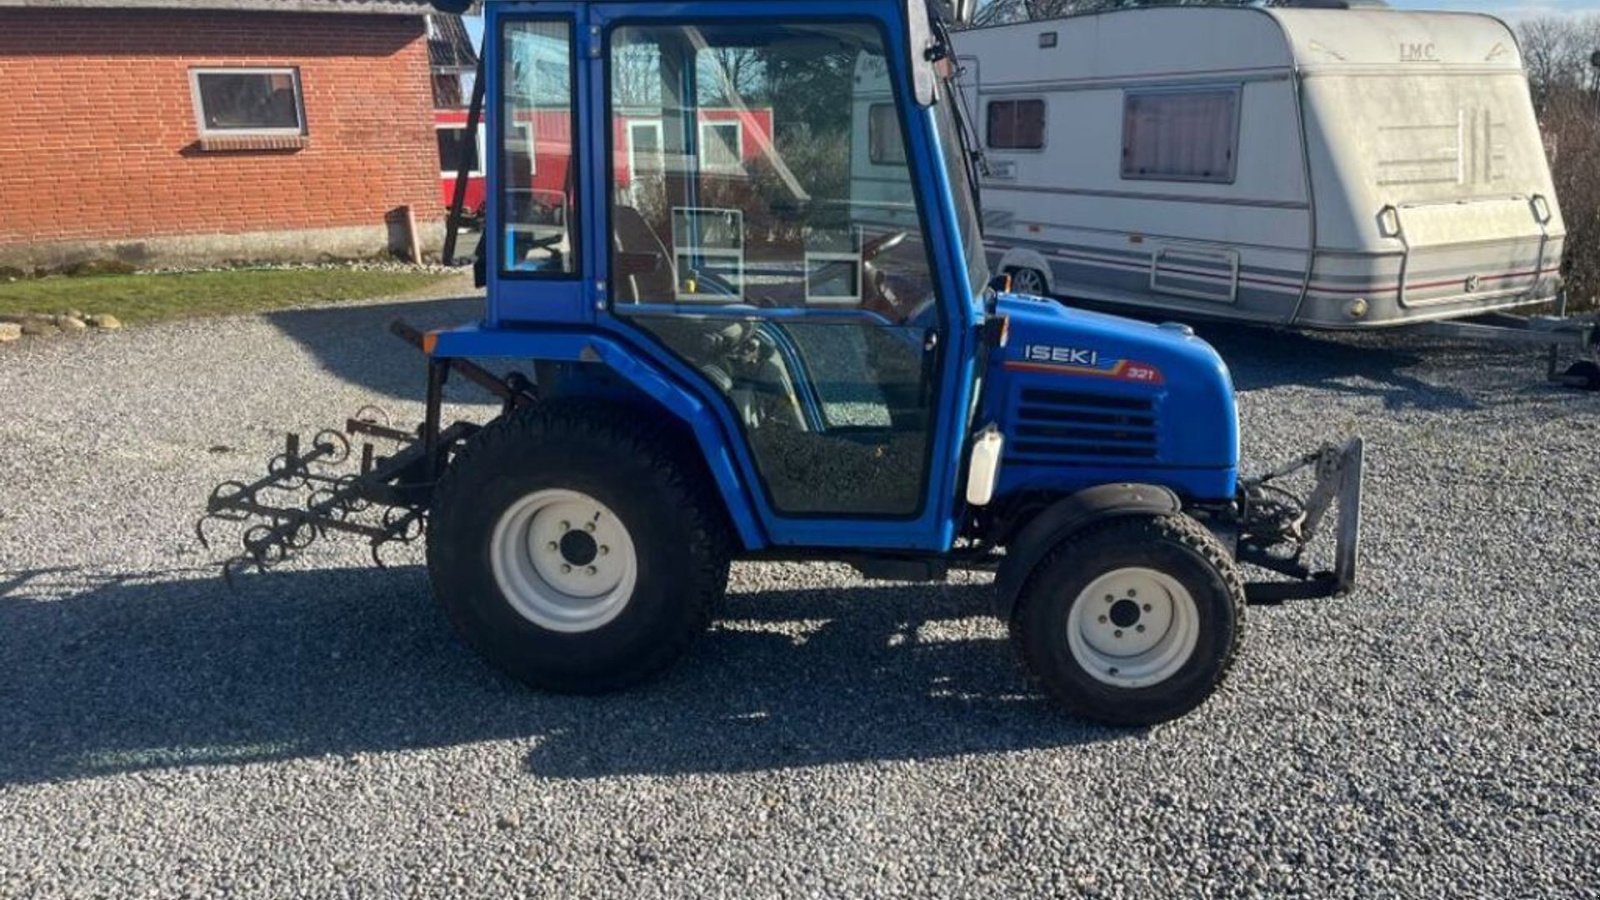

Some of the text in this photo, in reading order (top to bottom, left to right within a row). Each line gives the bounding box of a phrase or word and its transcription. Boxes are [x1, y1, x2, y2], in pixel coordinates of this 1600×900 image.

[1399, 42, 1436, 60] LMC
[1024, 344, 1097, 366] ISEKI
[1126, 367, 1154, 380] 321
